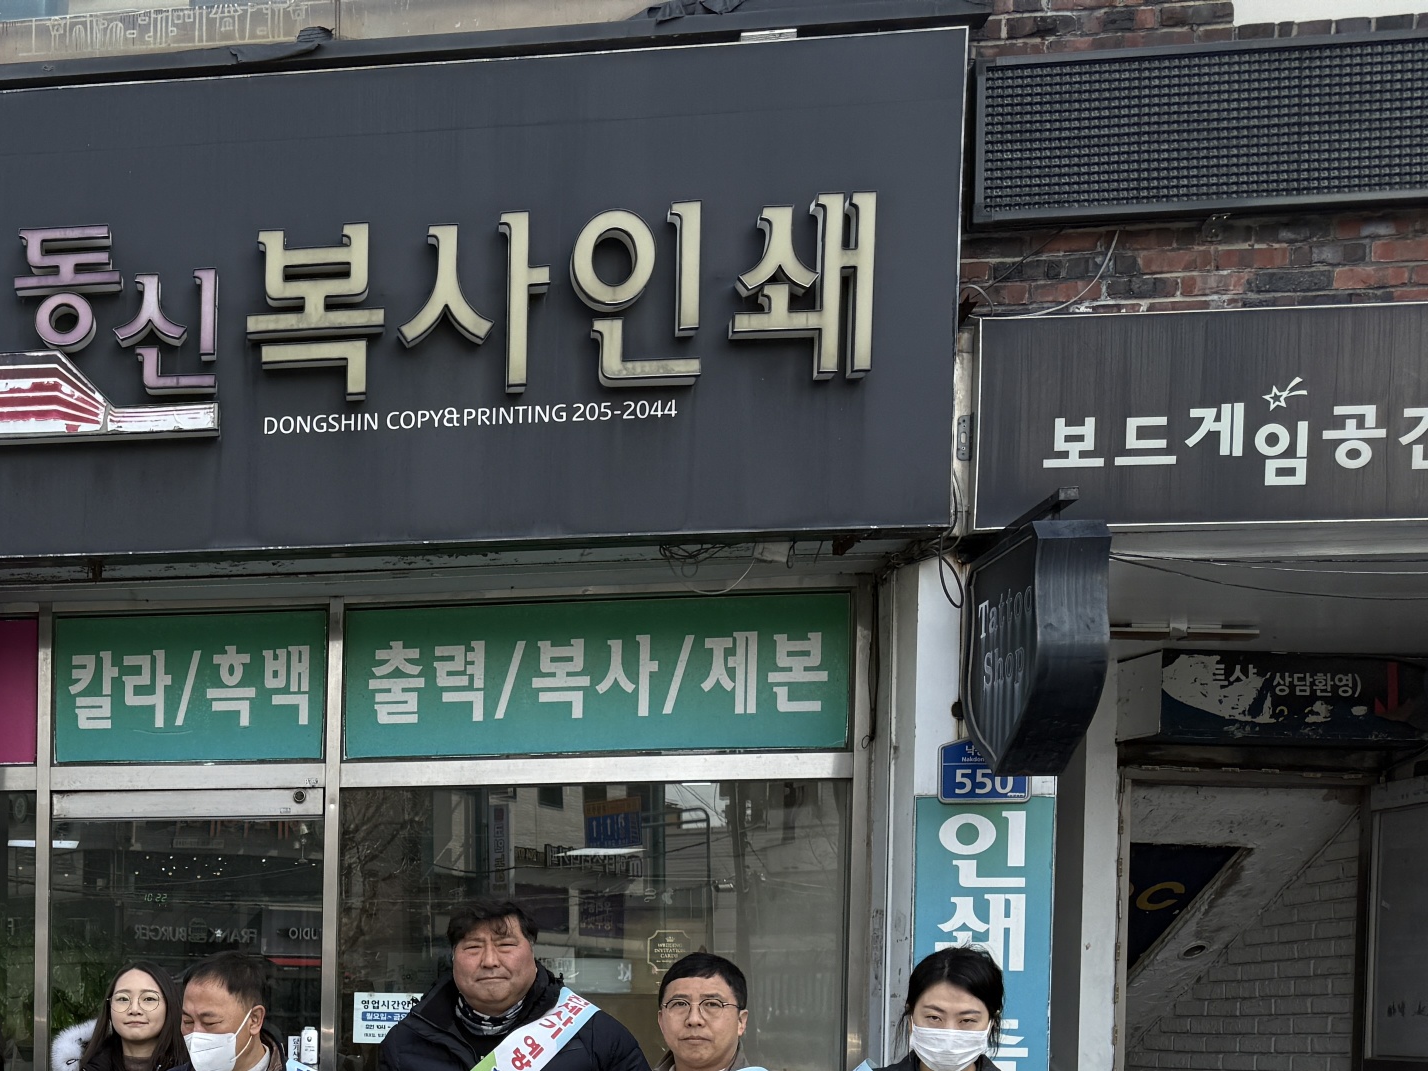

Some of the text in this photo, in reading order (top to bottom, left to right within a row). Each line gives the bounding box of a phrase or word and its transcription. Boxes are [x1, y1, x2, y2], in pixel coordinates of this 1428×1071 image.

[14, 191, 878, 402] 동신 복사인쇄
[263, 399, 678, 435] DONGSHIN COPY&PRINTING 205-2044
[978, 585, 1033, 639] Tattoo
[68, 644, 312, 731] 칼라/흑백
[368, 630, 829, 726] 출력/복사/제본
[983, 647, 1025, 690] Shop
[955, 769, 1014, 794] 550
[361, 1000, 411, 1010] 영업시간안
[511, 1035, 545, 1071] 예방
